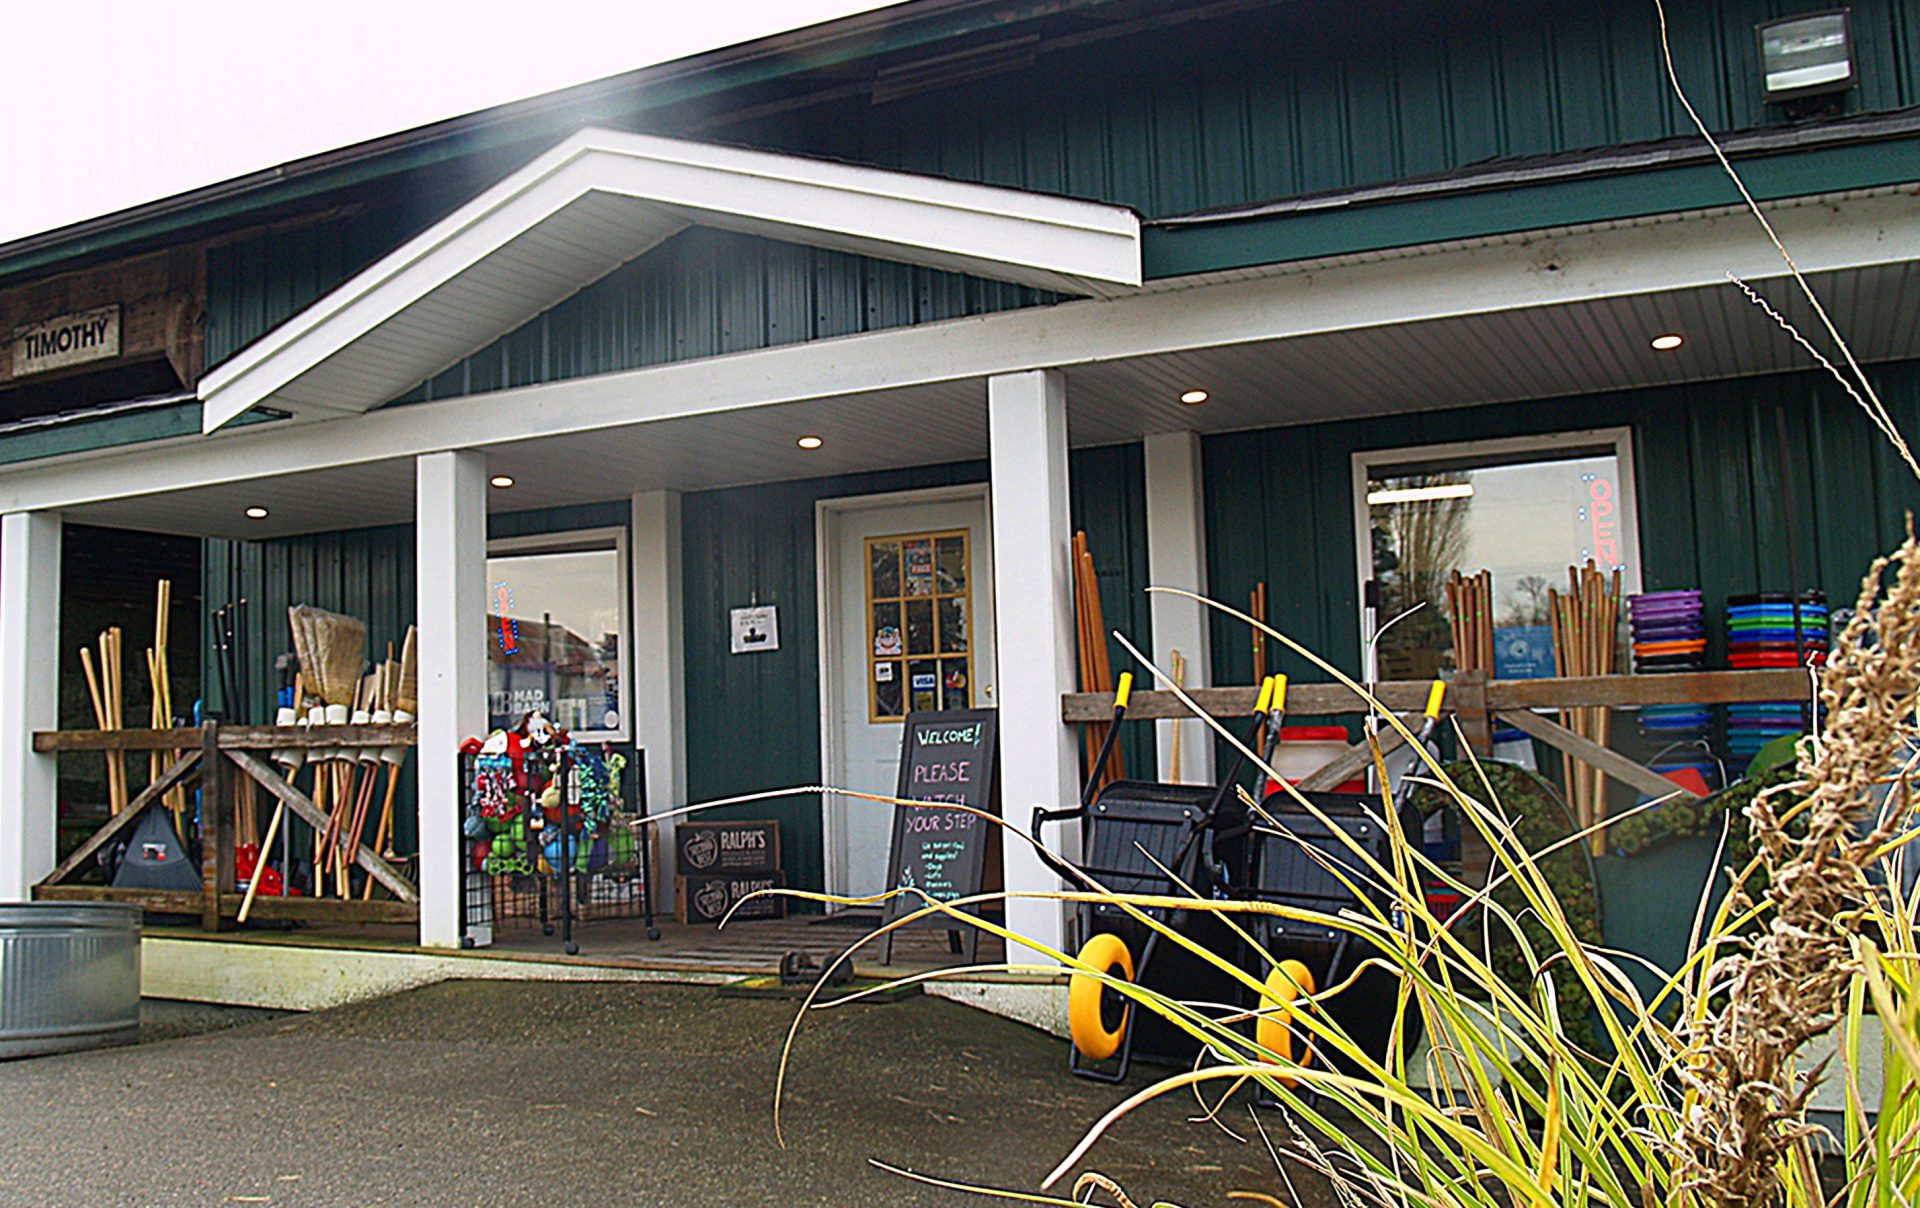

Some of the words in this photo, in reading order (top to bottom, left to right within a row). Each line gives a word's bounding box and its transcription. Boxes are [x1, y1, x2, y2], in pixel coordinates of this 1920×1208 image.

[25, 319, 108, 360] TIMOTHY
[1590, 480, 1619, 567] OPEN
[915, 677, 934, 686] VISA
[514, 689, 543, 702] MAD
[917, 723, 981, 749] WELCOME!
[914, 762, 970, 783] PLEASE
[906, 815, 941, 834] YOUR
[944, 813, 977, 831] STEP
[721, 831, 766, 850] RALPH'S
